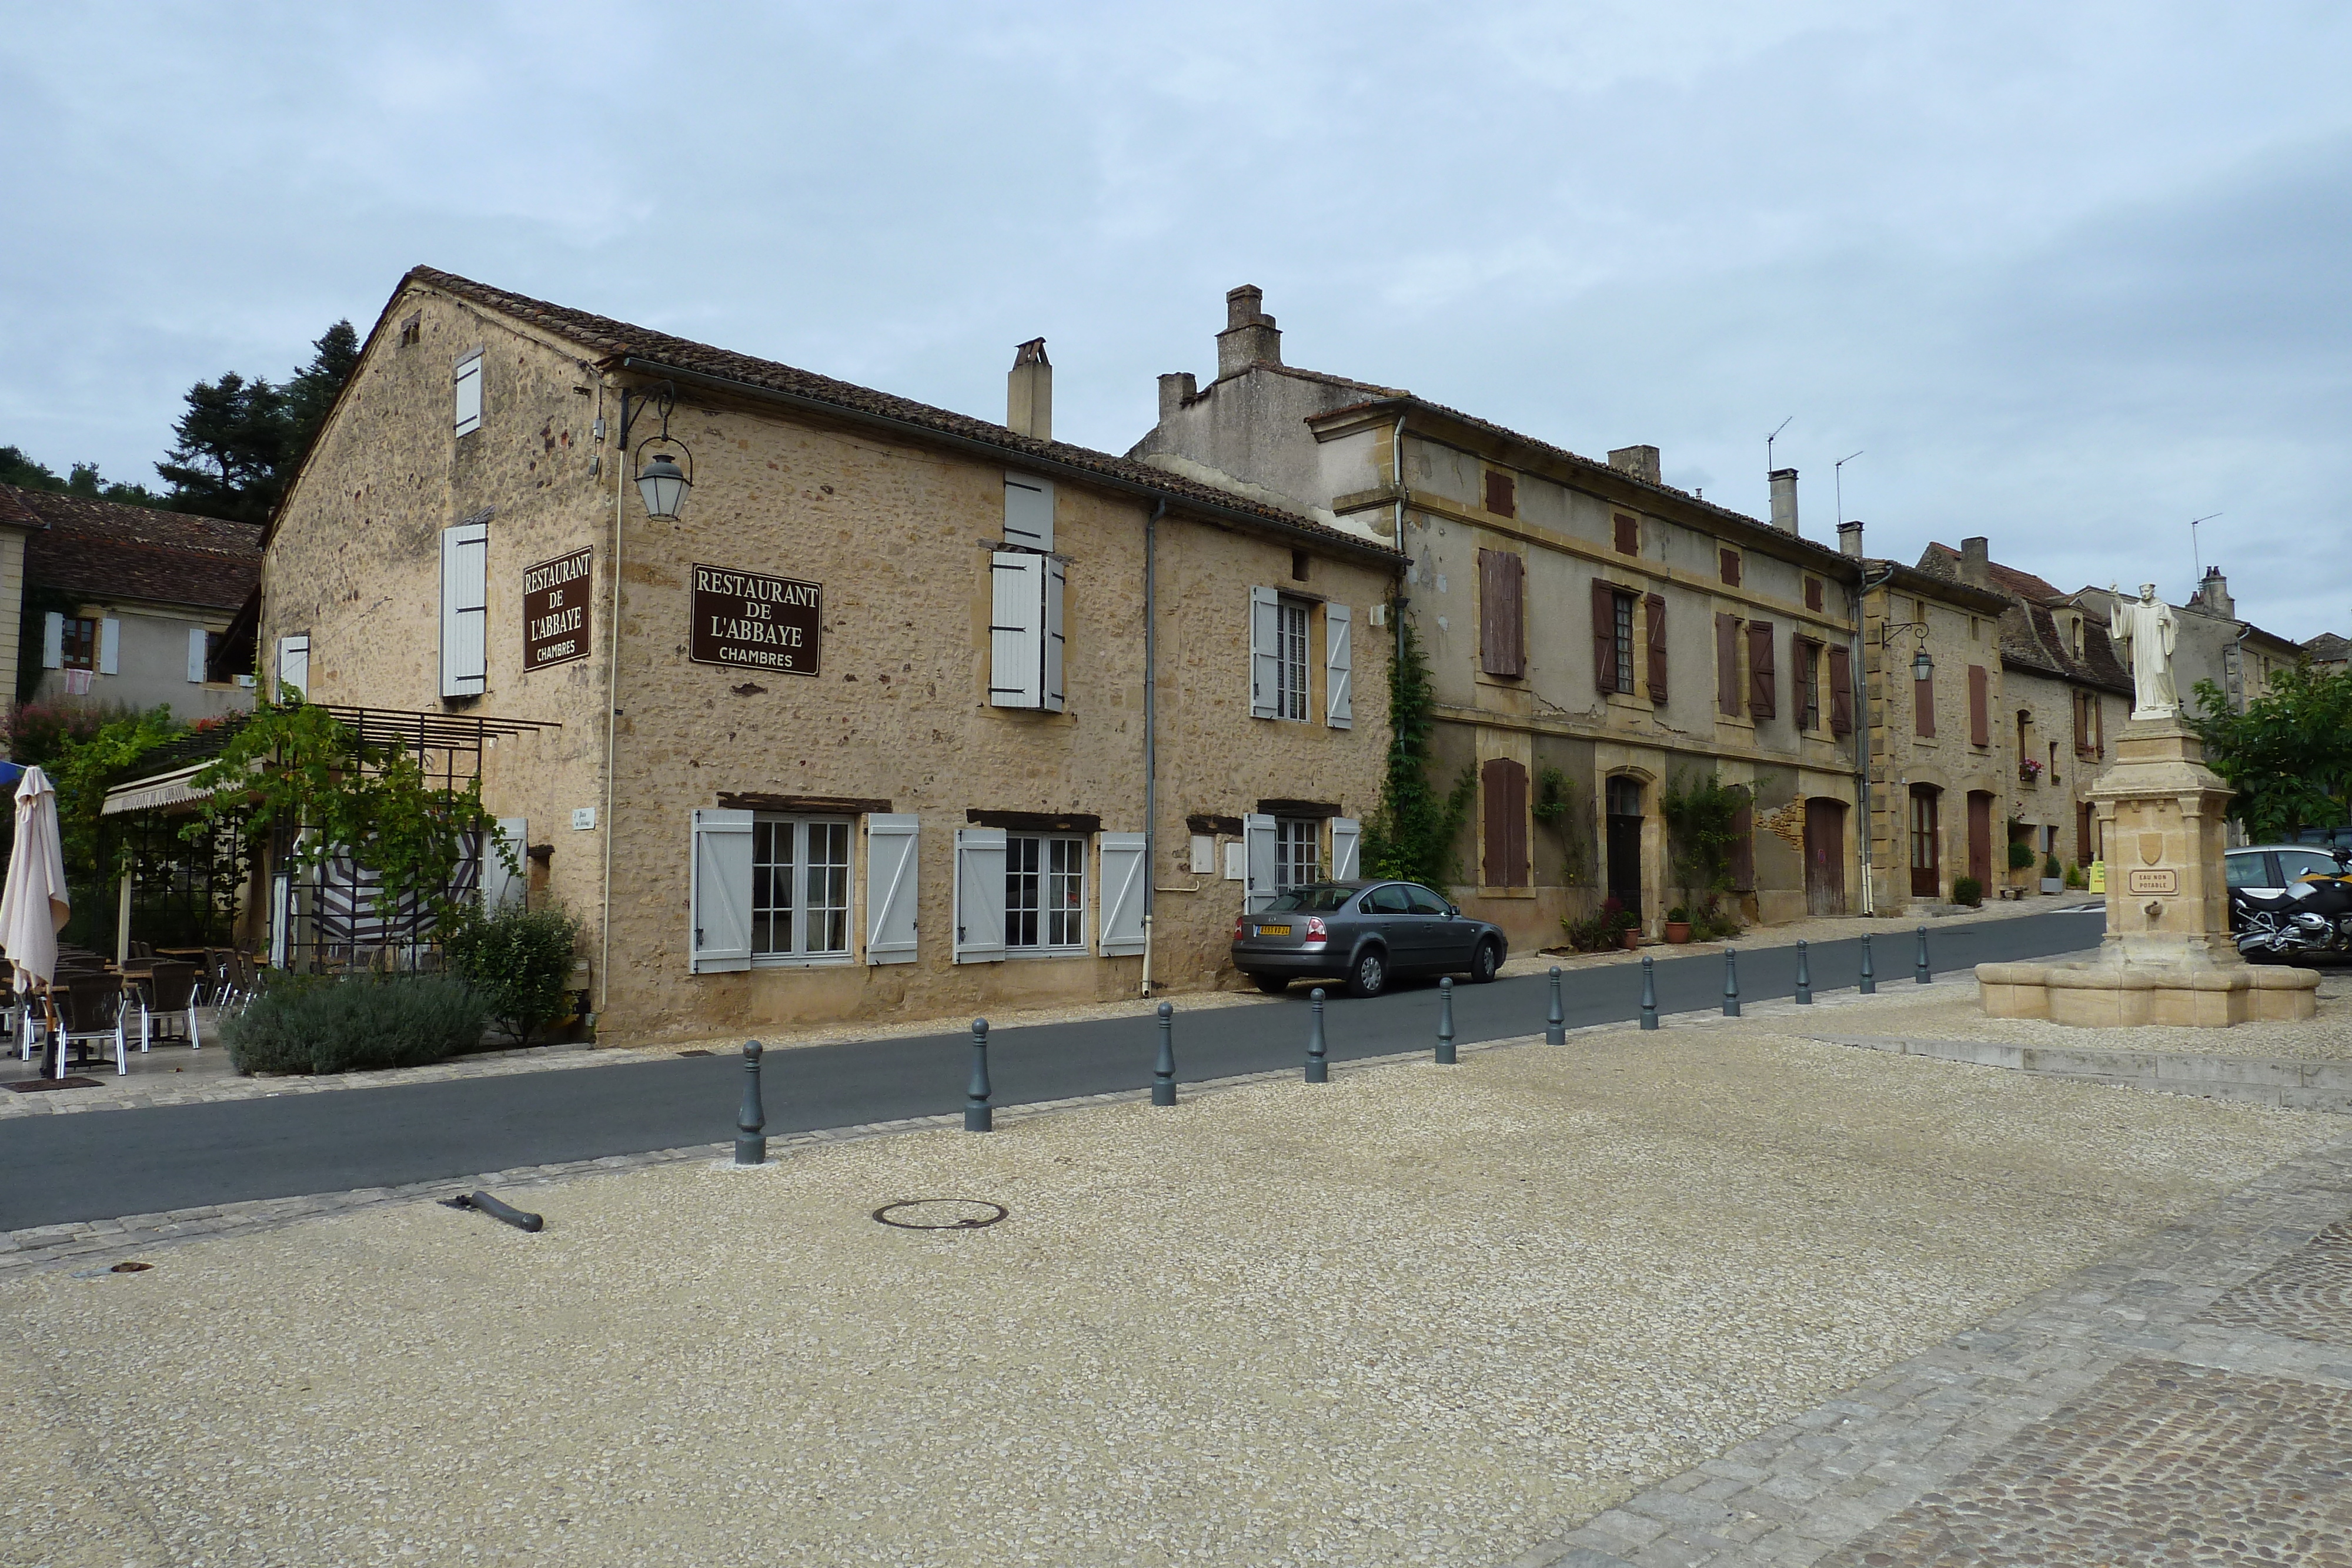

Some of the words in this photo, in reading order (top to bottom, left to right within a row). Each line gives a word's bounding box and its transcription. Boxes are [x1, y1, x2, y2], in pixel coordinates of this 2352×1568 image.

[525, 553, 590, 595] RESTAURANT
[549, 589, 563, 609] DE
[697, 570, 818, 608] RESTAURANT
[531, 606, 582, 641] L'ABBAYE
[745, 601, 772, 620] DE
[710, 616, 803, 647] L'ABBAYE
[537, 639, 575, 662] CHAMBRES
[719, 647, 793, 667] CHAMBRES
